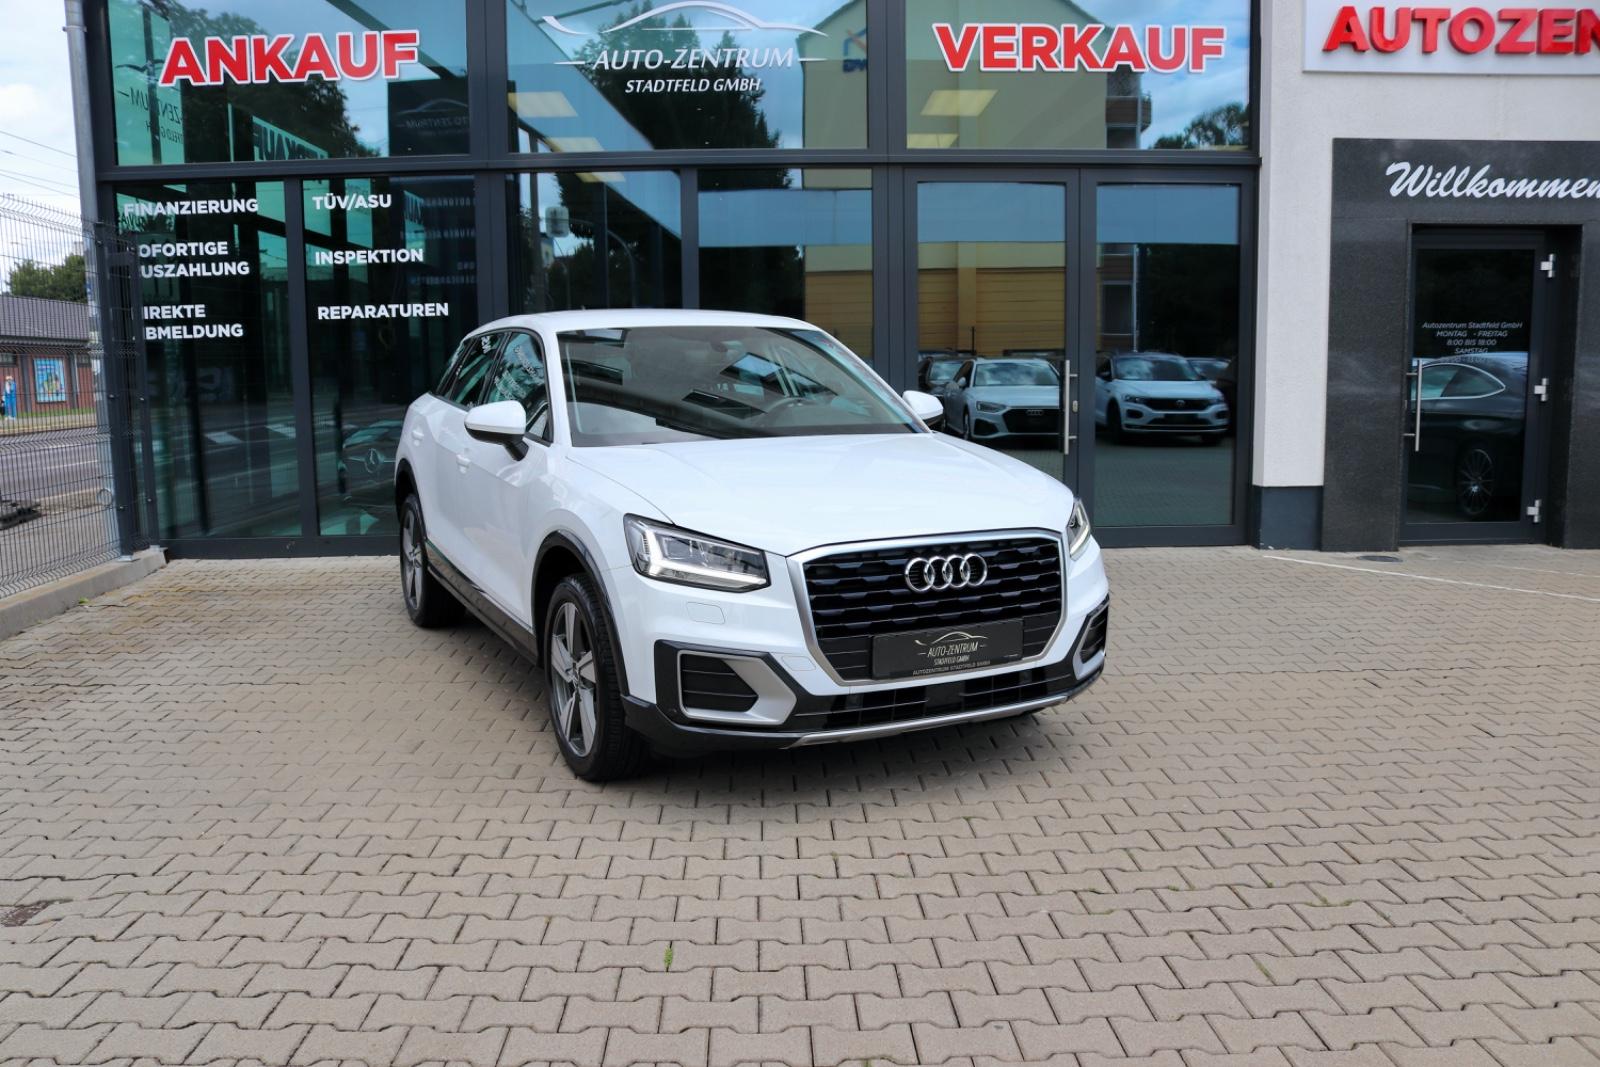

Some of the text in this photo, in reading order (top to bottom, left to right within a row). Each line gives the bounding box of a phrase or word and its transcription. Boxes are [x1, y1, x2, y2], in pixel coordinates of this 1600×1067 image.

[933, 23, 1226, 73] VERKAUF
[160, 30, 419, 87] ANKAUF
[594, 48, 793, 70] AUTO-ZENTRUM
[625, 78, 761, 94] STADTFELD GMBH
[1386, 162, 1600, 198] Willkommen
[123, 198, 259, 216] FINANZIERUNG
[312, 193, 392, 210] TÜV/ASU
[138, 241, 229, 258] OFORTIGE
[315, 248, 424, 265] INSPEKTION
[140, 261, 250, 279] USZAHLUNG
[143, 304, 206, 320] IREKTE
[317, 302, 449, 320] REPARATUREN
[144, 323, 243, 340] BMELDUNG
